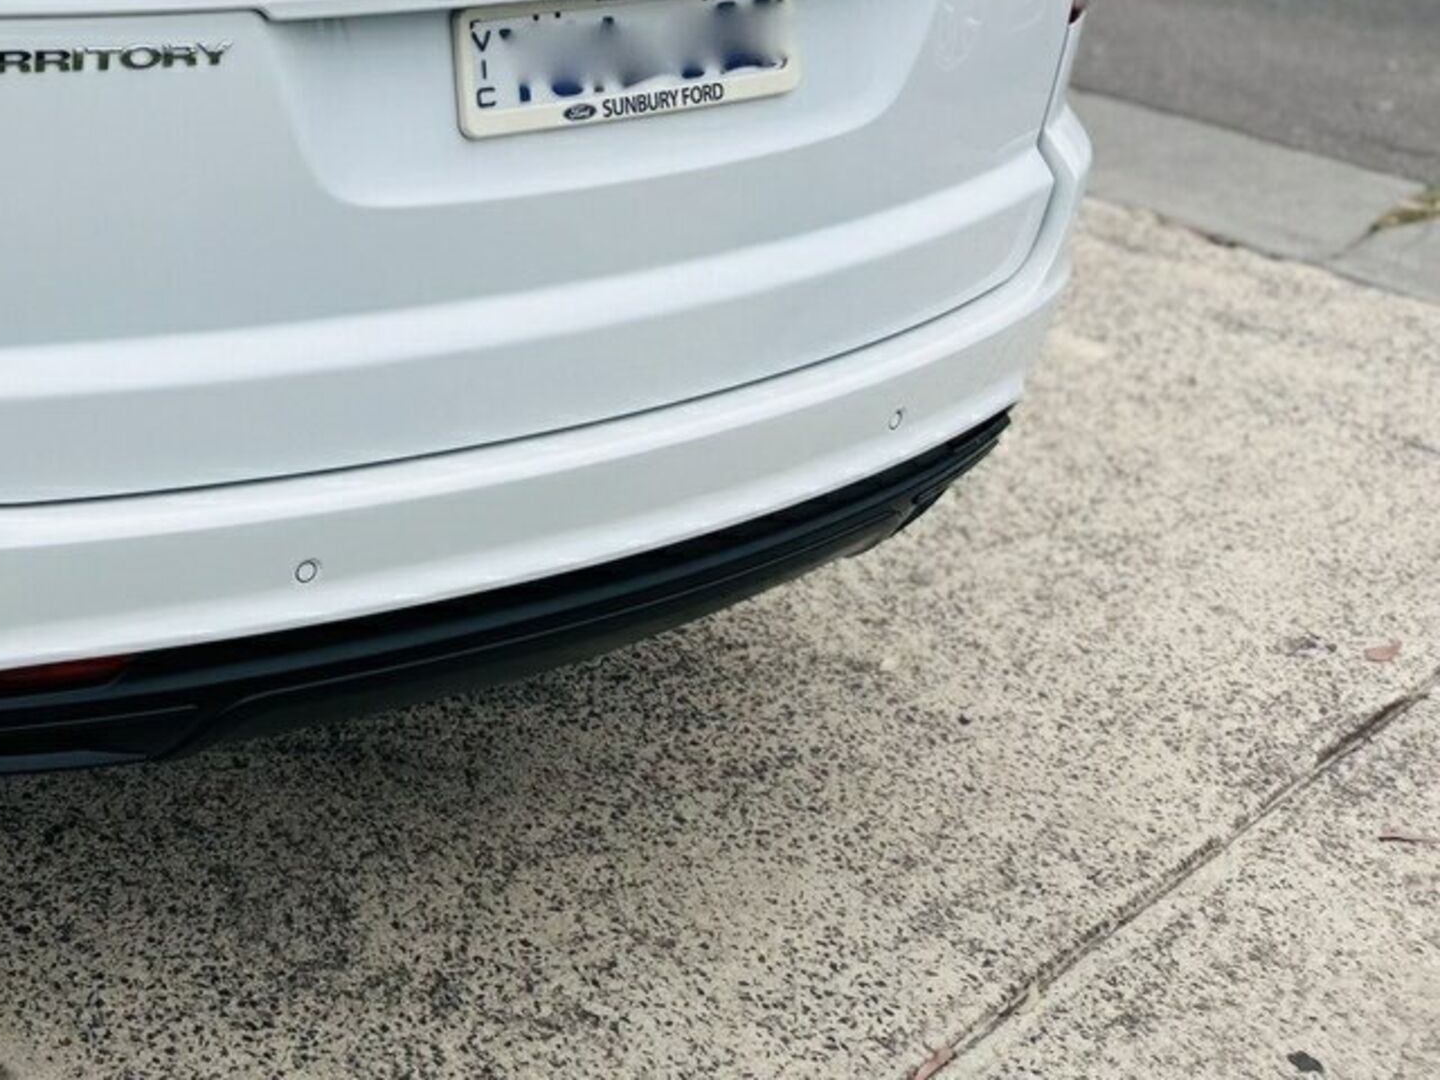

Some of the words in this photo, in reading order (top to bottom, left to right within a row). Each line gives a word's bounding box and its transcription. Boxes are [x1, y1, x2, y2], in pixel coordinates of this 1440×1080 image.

[471, 29, 497, 109] VIC
[601, 90, 679, 118] SUNBURY
[681, 82, 725, 106] FORD
